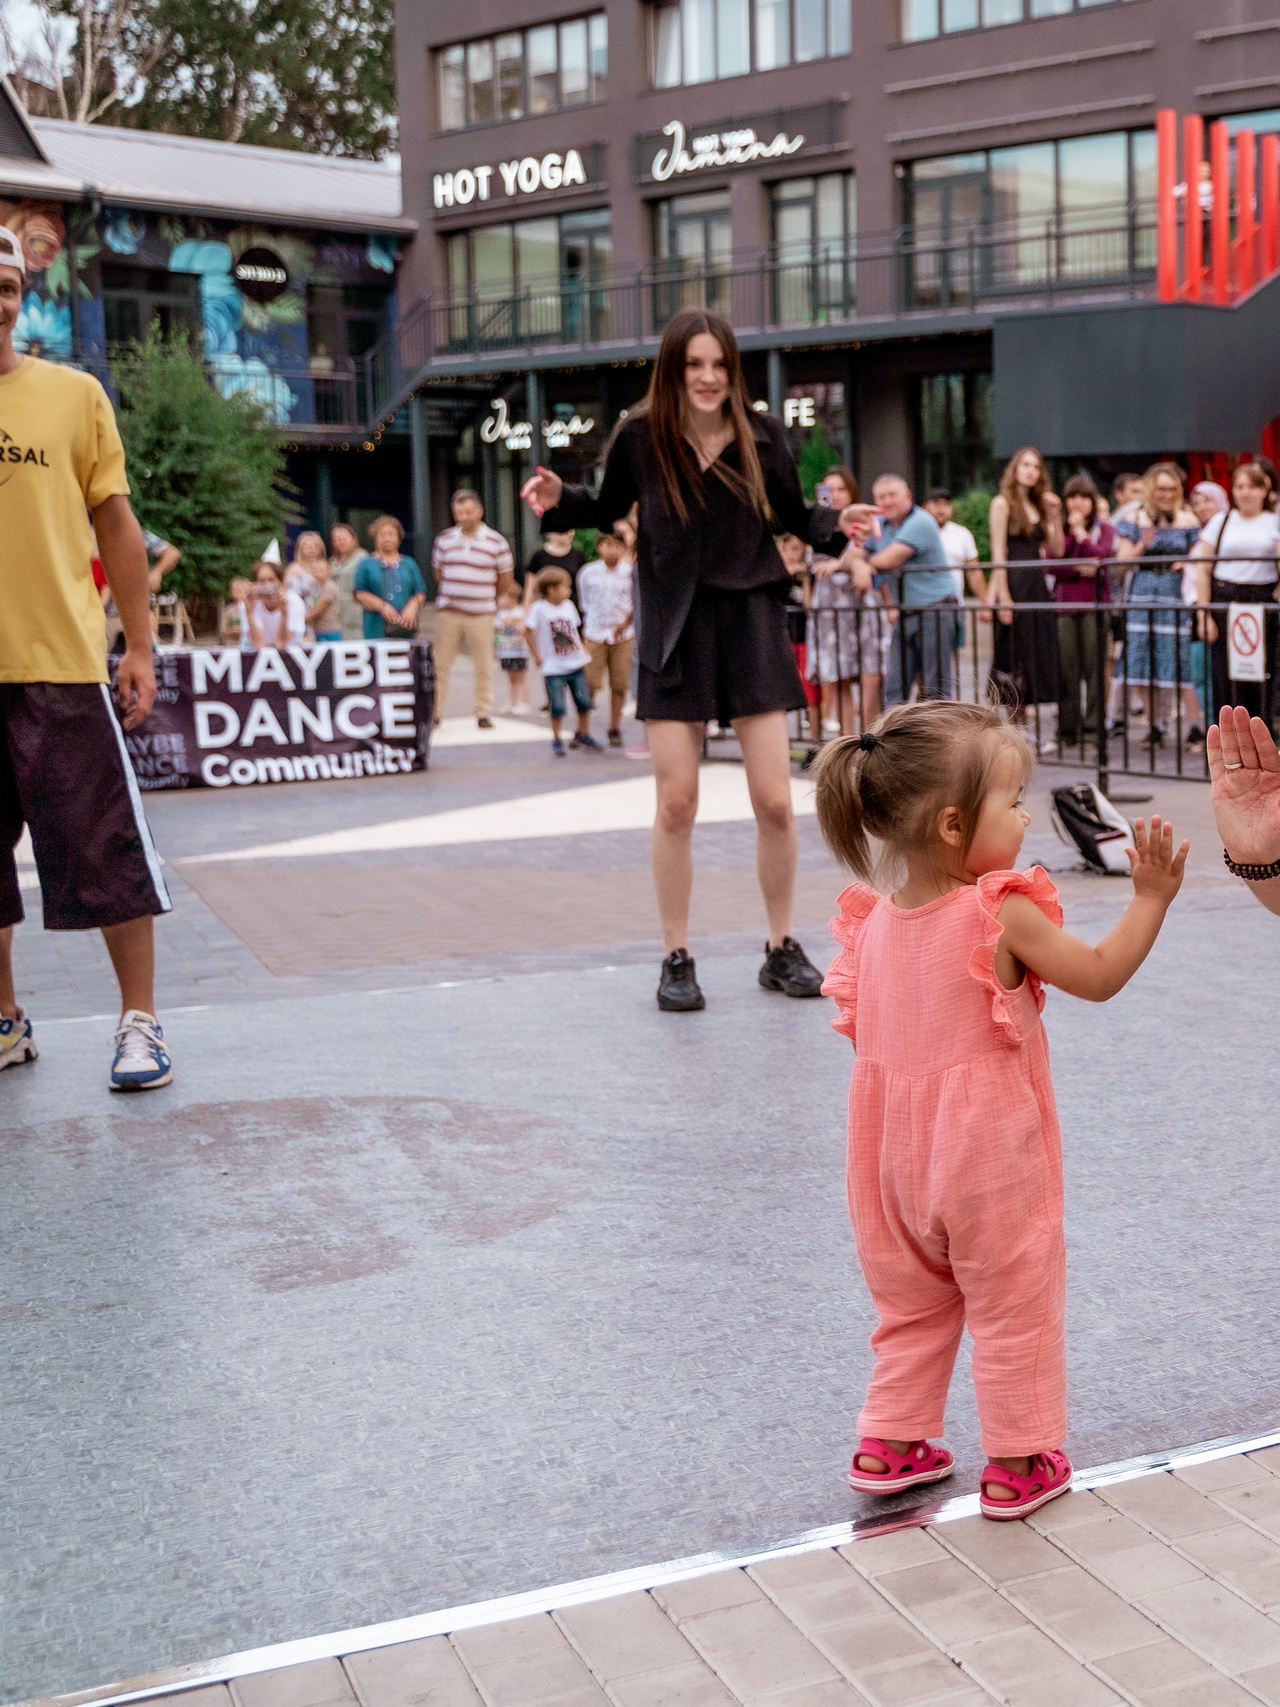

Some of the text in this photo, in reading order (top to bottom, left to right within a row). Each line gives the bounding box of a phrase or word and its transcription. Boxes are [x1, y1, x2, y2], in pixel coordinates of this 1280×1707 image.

[433, 148, 587, 209] HOT YOGA
[190, 640, 415, 694] MAYBE
[194, 692, 417, 749] DANCE
[202, 744, 417, 788] Community
